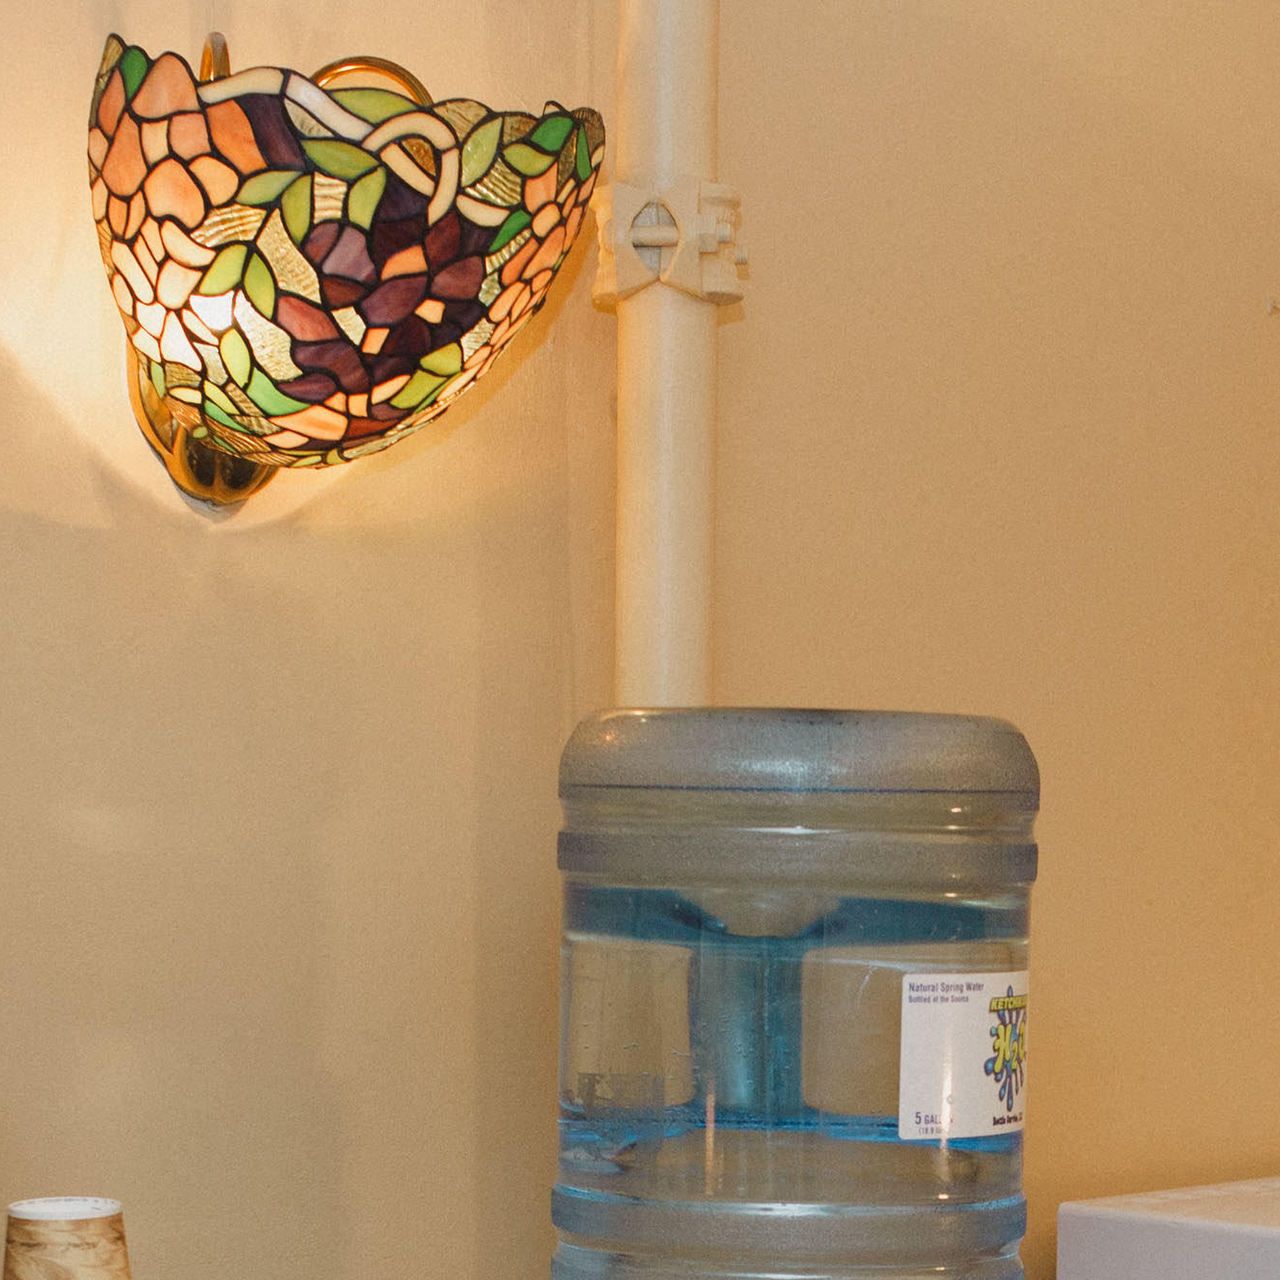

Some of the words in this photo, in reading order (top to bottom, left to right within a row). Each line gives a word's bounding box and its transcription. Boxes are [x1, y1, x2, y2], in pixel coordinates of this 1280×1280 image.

[908, 982, 939, 993] Natural
[940, 981, 965, 994] Spring
[965, 982, 985, 992] Water
[914, 1111, 922, 1125] 5
